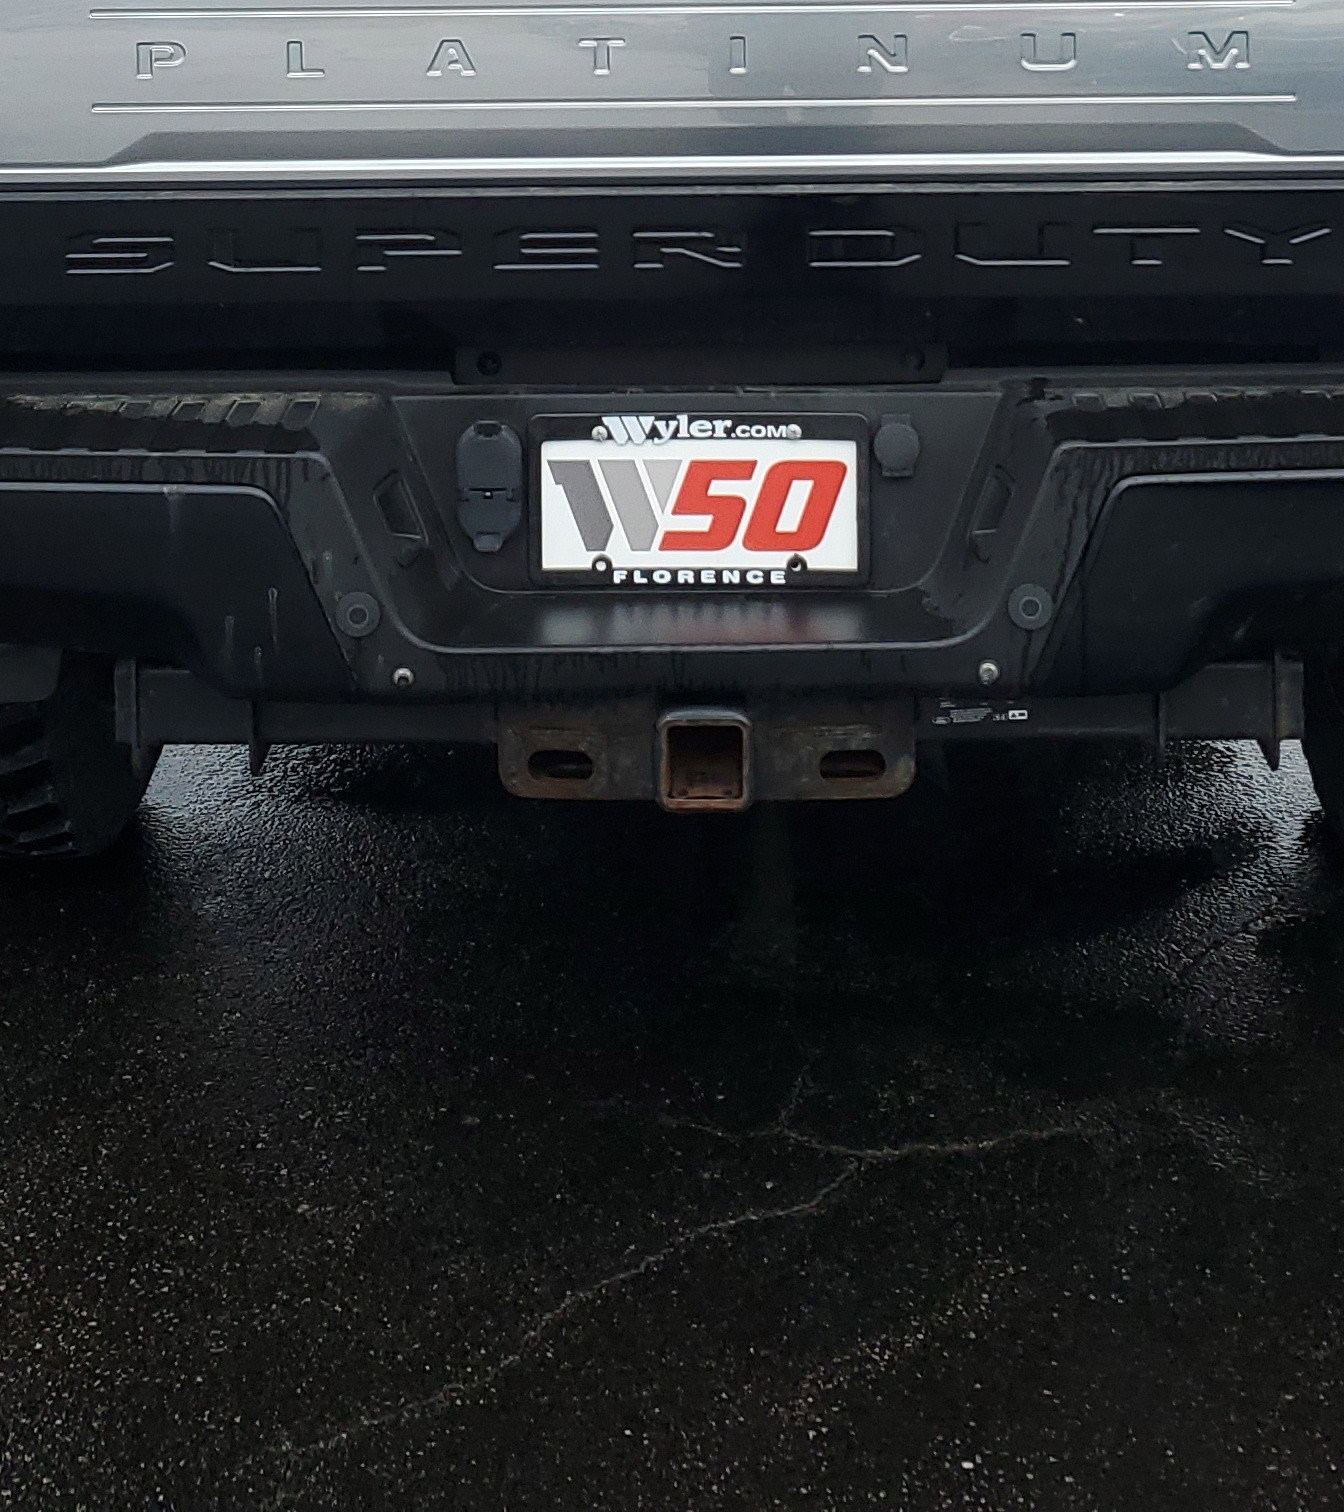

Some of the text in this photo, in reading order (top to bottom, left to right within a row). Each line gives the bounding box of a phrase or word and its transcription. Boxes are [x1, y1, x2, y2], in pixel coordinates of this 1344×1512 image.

[135, 30, 1251, 80] PLATINUM
[64, 222, 1333, 274] SUPER DUTY
[612, 569, 787, 585] FLORENCE
